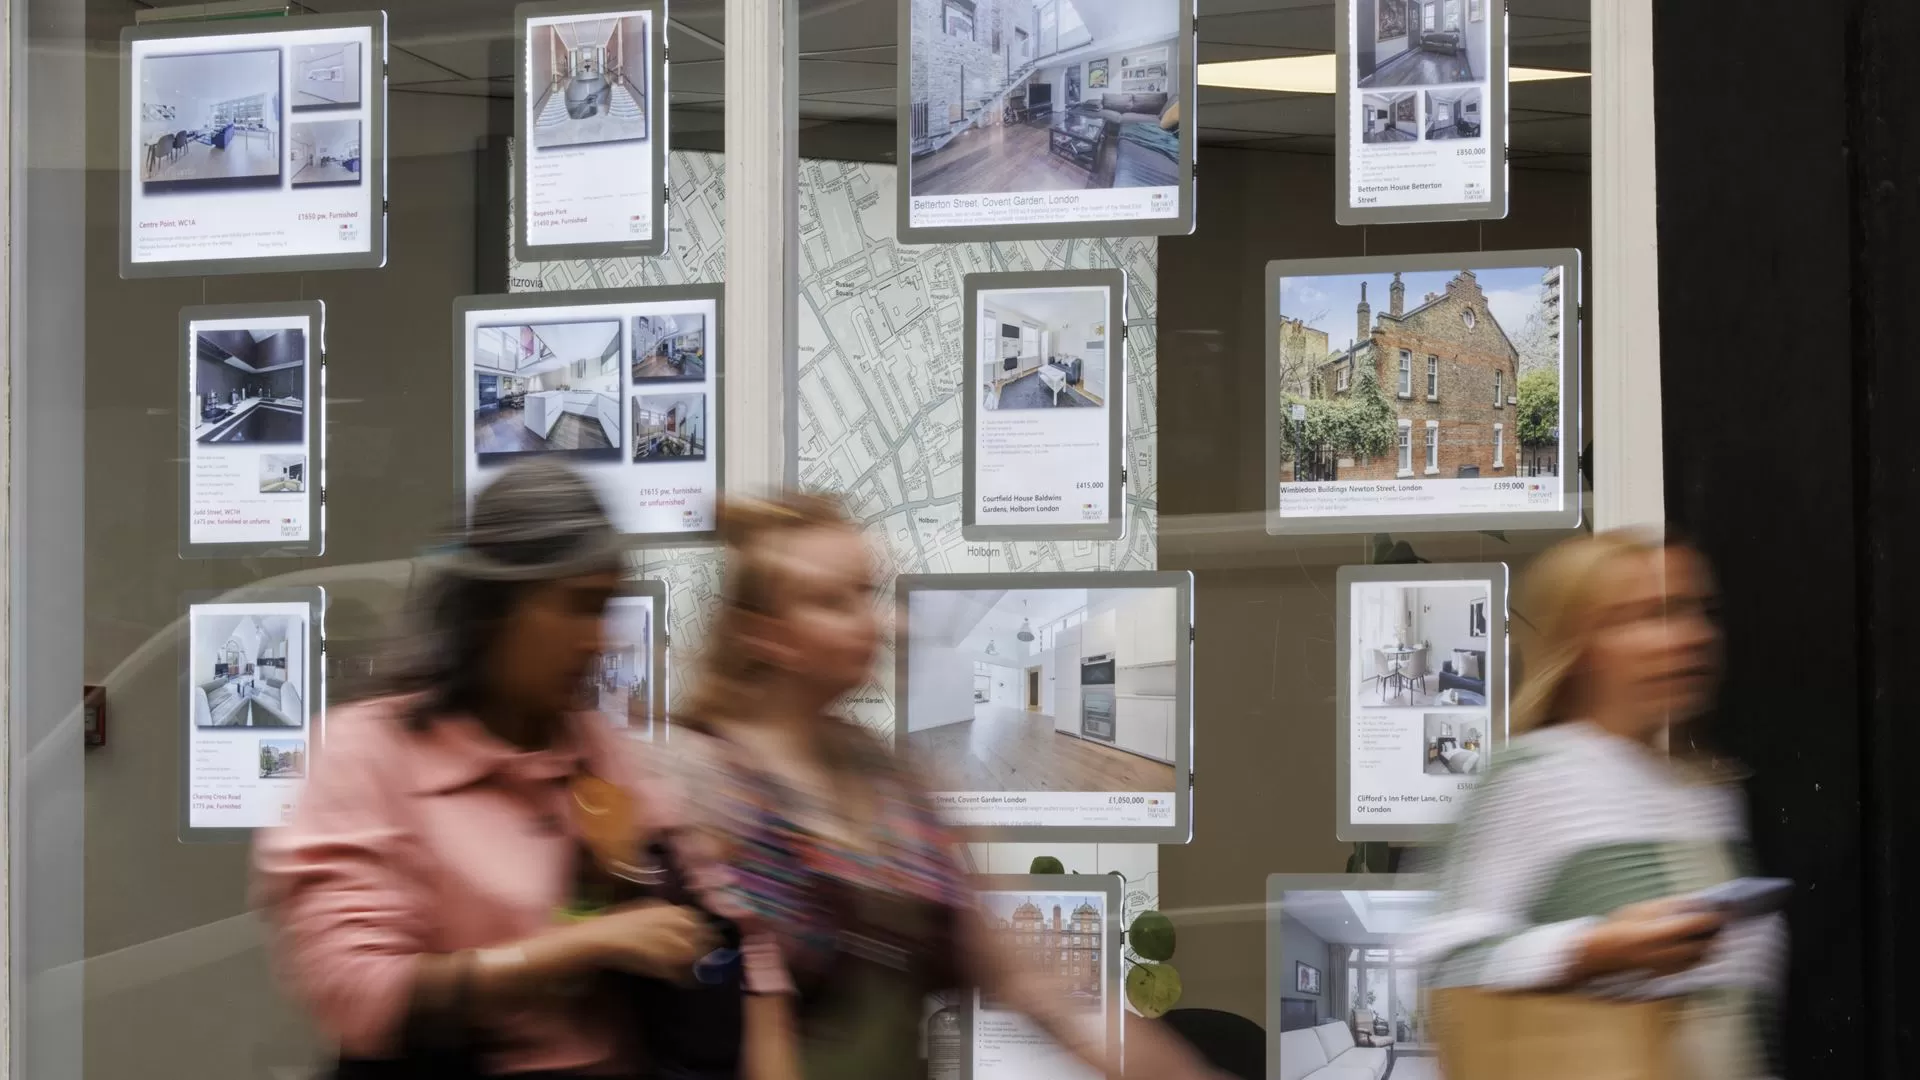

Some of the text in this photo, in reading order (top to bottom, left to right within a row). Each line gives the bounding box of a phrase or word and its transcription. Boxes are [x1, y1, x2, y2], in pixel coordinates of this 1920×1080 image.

[1456, 148, 1486, 156] £850,000
[1358, 185, 1388, 193] Betterton
[1412, 182, 1442, 190] Betterton
[914, 195, 1080, 210] Betterton Street, Covent Garden, London
[298, 213, 316, 221] £1650
[329, 211, 358, 220] Furnished
[562, 216, 588, 225] Furnished
[139, 220, 158, 229] Centre
[178, 218, 196, 228] WC1A
[640, 488, 658, 496] £1615
[672, 486, 702, 494] furnished
[1318, 486, 1348, 494] Buildings
[983, 505, 1008, 513] Gardens,
[968, 546, 1000, 557] Holborn
[1108, 796, 1144, 805] £1,050,000
[1440, 796, 1452, 804] City
